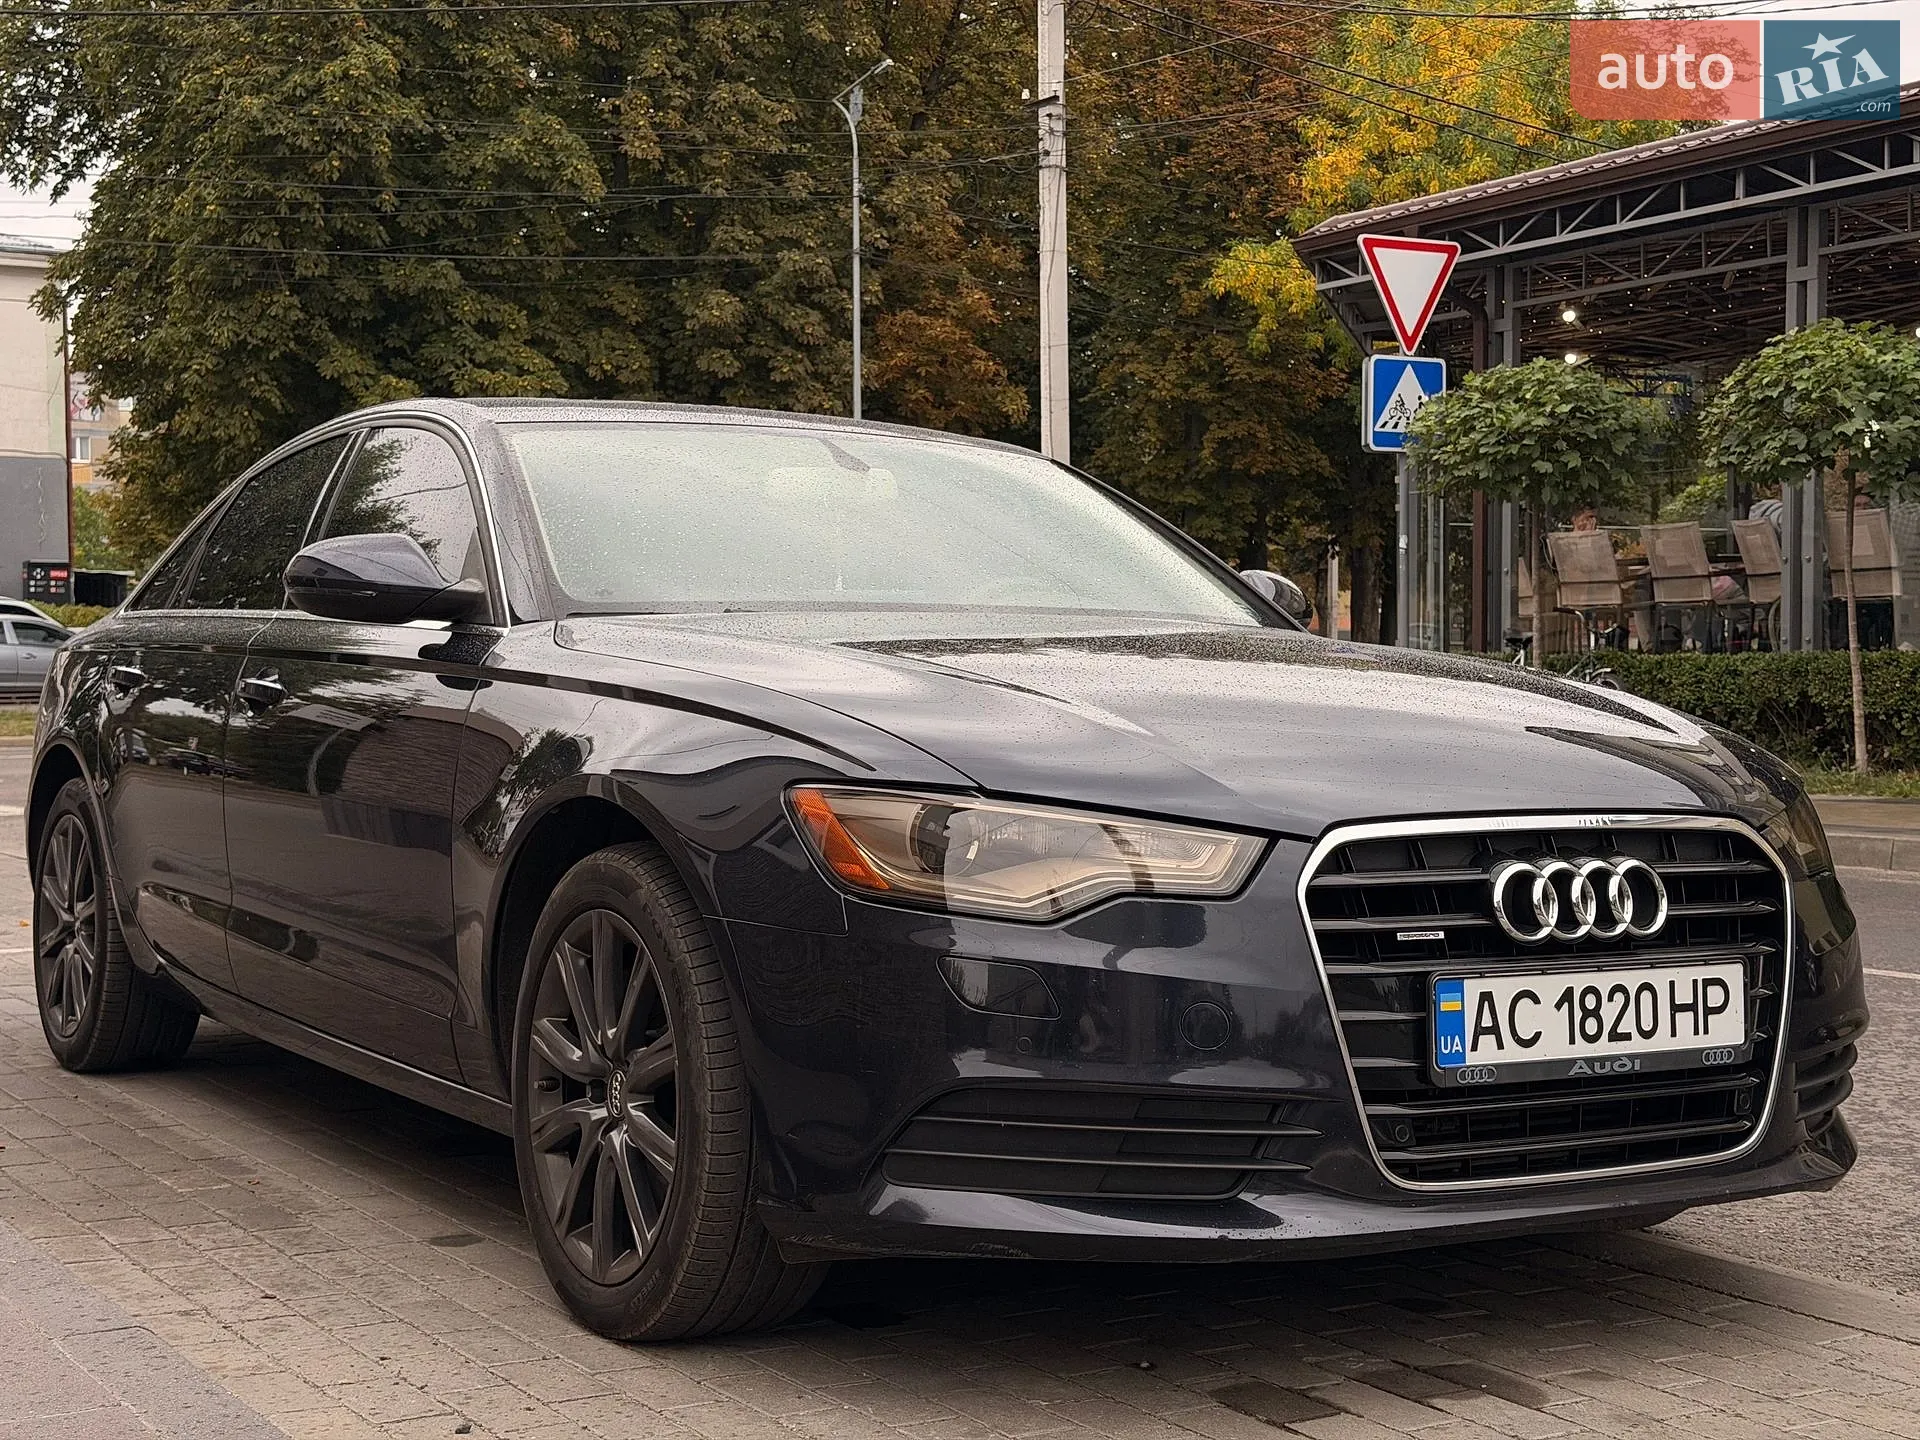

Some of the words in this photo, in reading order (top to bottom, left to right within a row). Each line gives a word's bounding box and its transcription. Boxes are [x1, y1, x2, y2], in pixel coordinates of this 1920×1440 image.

[1470, 989, 1542, 1052] AC
[1554, 981, 1659, 1045] 1820
[1669, 977, 1730, 1037] HP
[1440, 1035, 1463, 1054] UA
[1568, 1056, 1641, 1077] Audi
